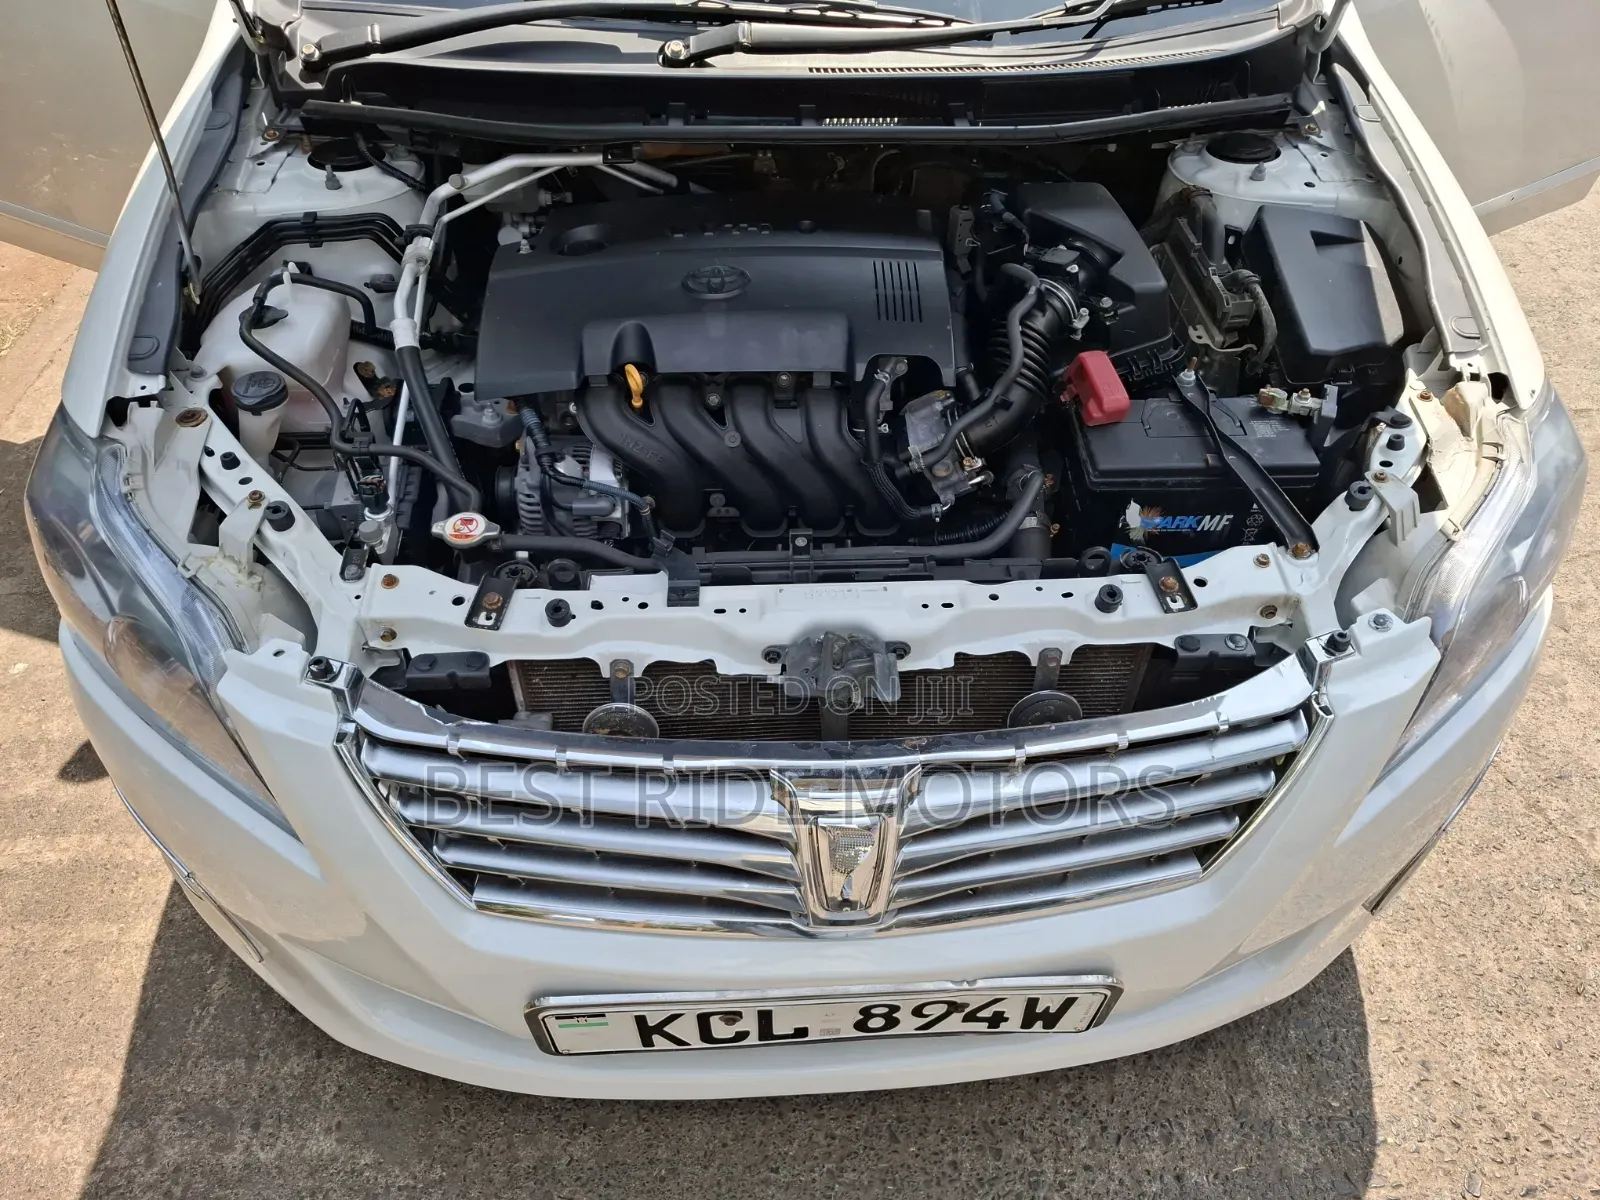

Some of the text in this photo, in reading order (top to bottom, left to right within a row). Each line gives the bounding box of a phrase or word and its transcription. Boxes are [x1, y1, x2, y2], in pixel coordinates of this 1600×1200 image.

[1196, 514, 1234, 532] MF
[633, 1009, 809, 1047] KCL
[853, 996, 1078, 1033] 894W
